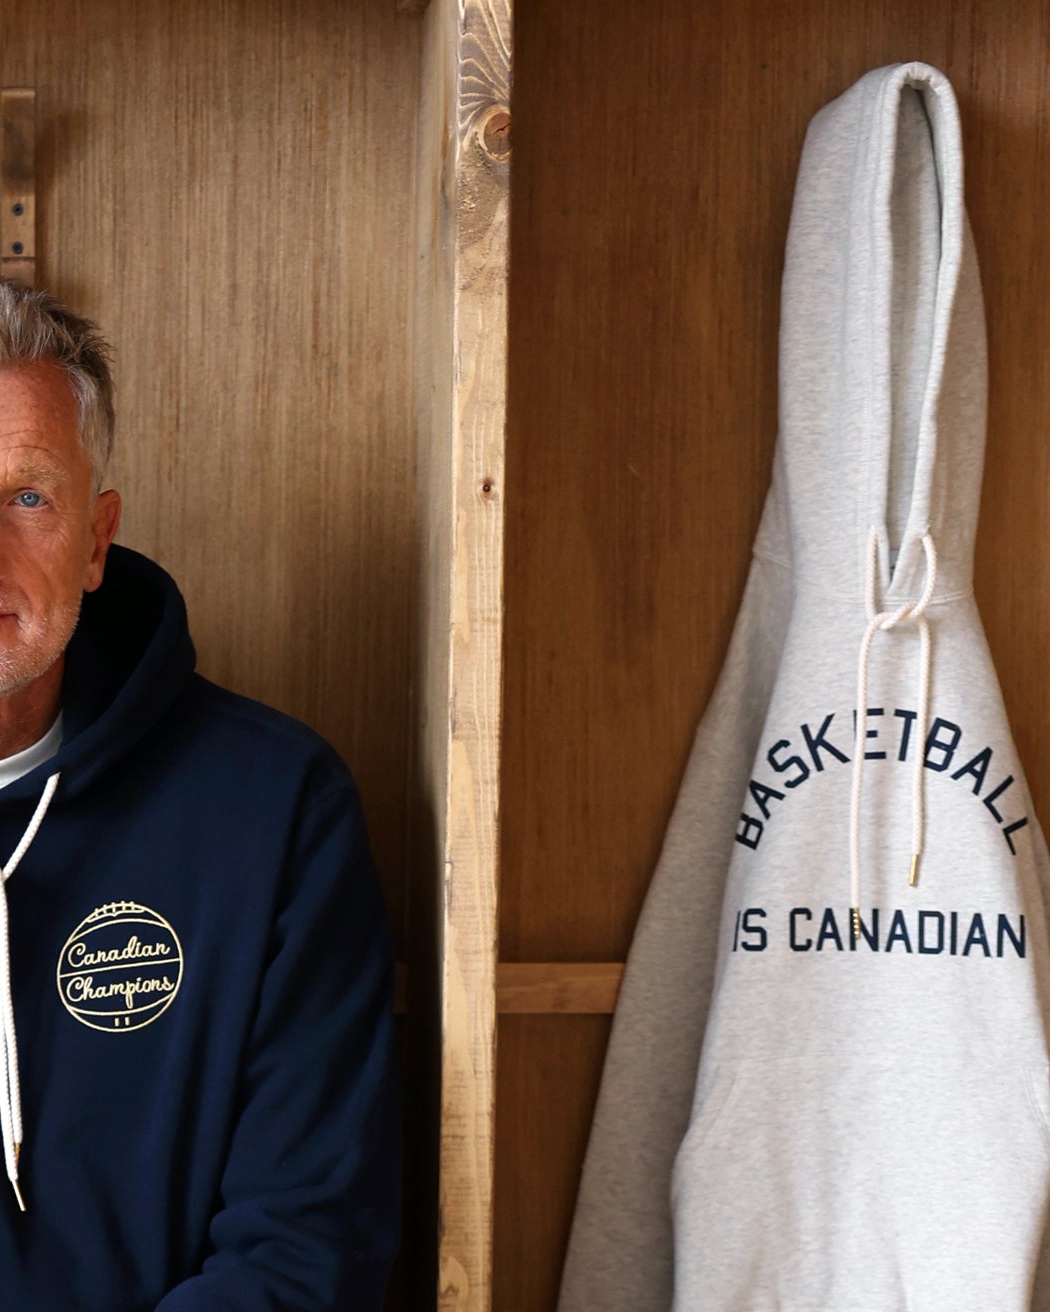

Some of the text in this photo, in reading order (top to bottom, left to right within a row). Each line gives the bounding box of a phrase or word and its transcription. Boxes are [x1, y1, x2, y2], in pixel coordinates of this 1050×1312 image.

[734, 707, 1029, 857] BASKETBALL
[67, 935, 171, 968] Canadian
[732, 907, 1027, 959] IS CANADIAN
[66, 976, 175, 1010] Champions
